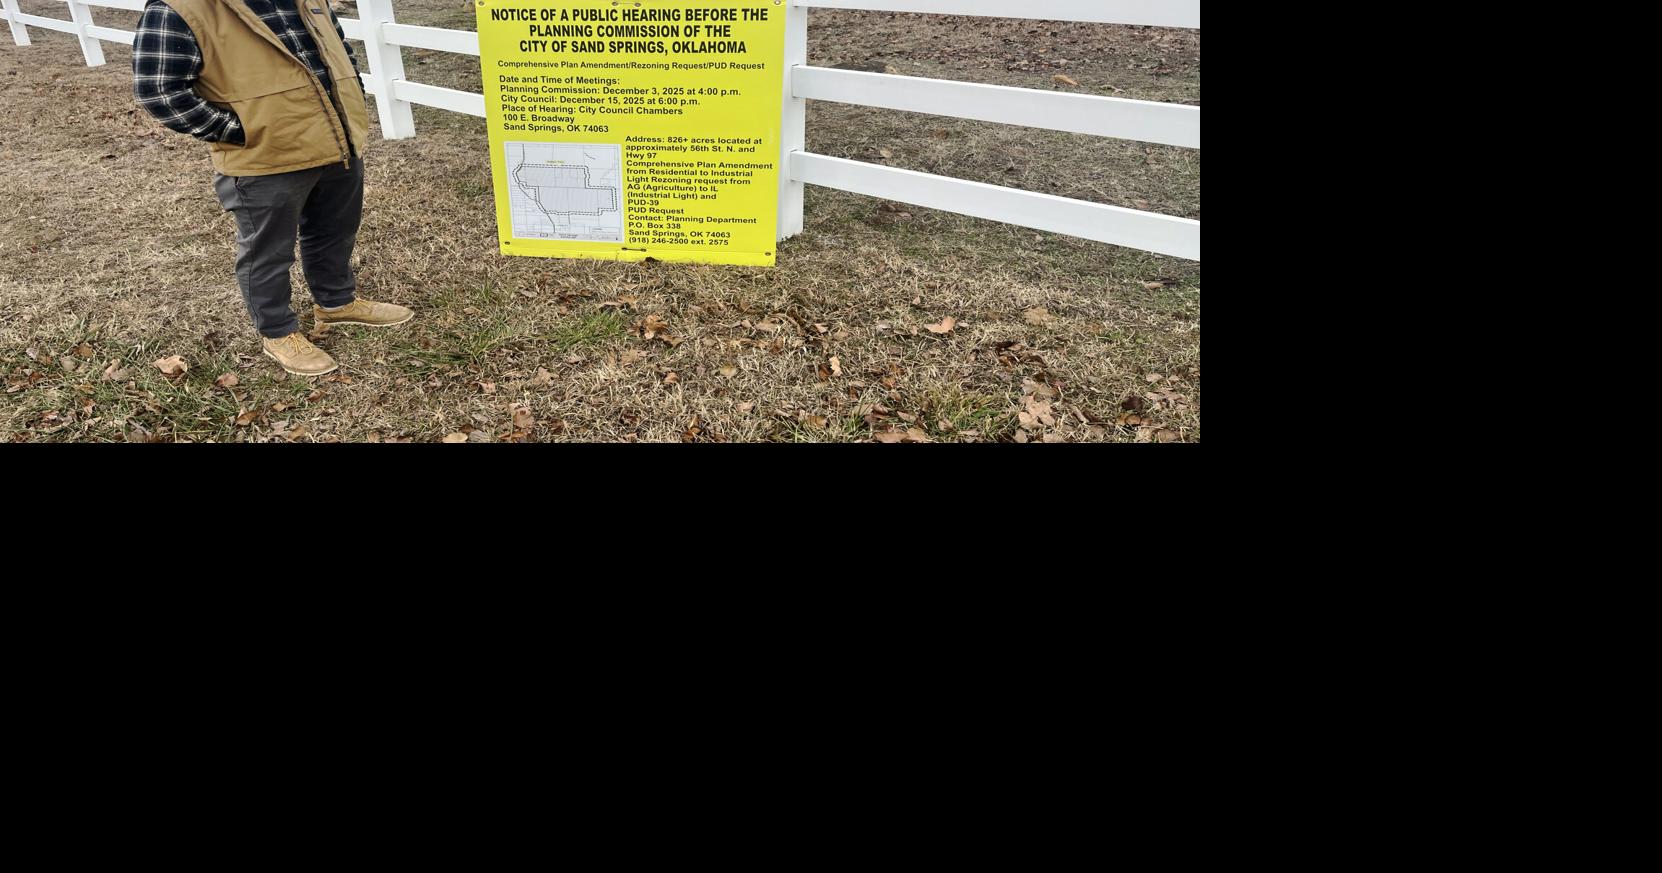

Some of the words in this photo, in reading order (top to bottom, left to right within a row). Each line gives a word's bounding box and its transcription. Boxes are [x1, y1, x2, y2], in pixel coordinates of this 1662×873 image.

[491, 8, 537, 21] NOTICE
[540, 8, 556, 21] OF
[560, 9, 569, 21] A
[572, 8, 618, 22] PUBLIC
[622, 8, 681, 22] HEARING
[685, 8, 737, 21] BEFORE
[742, 8, 768, 21] THE
[529, 24, 593, 38] PLANNING
[596, 25, 679, 38] COMMISSION
[683, 25, 701, 38] OF
[704, 25, 731, 38] THE
[520, 40, 548, 52] CITY
[551, 40, 567, 53] OF
[571, 40, 605, 53] SAND
[608, 41, 668, 55] SPRINGS,
[672, 41, 746, 54] OKLAHOMA
[498, 60, 559, 68] Comprehensive
[580, 61, 670, 70] Amendment/Rezoning
[672, 62, 727, 70] Request/PUD
[730, 62, 765, 70] Request
[499, 75, 519, 83] Date
[540, 76, 562, 84] Time
[576, 76, 620, 86] Meetings:
[500, 84, 539, 95] Planning
[541, 85, 600, 94] Commission:
[603, 86, 649, 95] December
[652, 87, 660, 96] 3,
[501, 94, 518, 104] City
[520, 94, 557, 103] Council:
[560, 96, 605, 104] December
[608, 96, 620, 105] 15,
[623, 96, 644, 104] 2025
[539, 105, 576, 114] Hearing:
[579, 106, 596, 115] City
[599, 106, 634, 114] Council
[636, 106, 683, 115] Chambers
[531, 114, 575, 124] Broadway
[504, 122, 526, 130] Sand
[528, 123, 564, 133] Springs,
[566, 124, 580, 132] OK
[626, 159, 694, 168] Comprehensive
[627, 176, 649, 184] Light
[651, 176, 692, 185] Rezoning
[643, 184, 697, 192] (Agriculture)
[627, 191, 670, 200] (Industrial
[666, 215, 704, 224] Planning
[652, 230, 687, 238] Springs,
